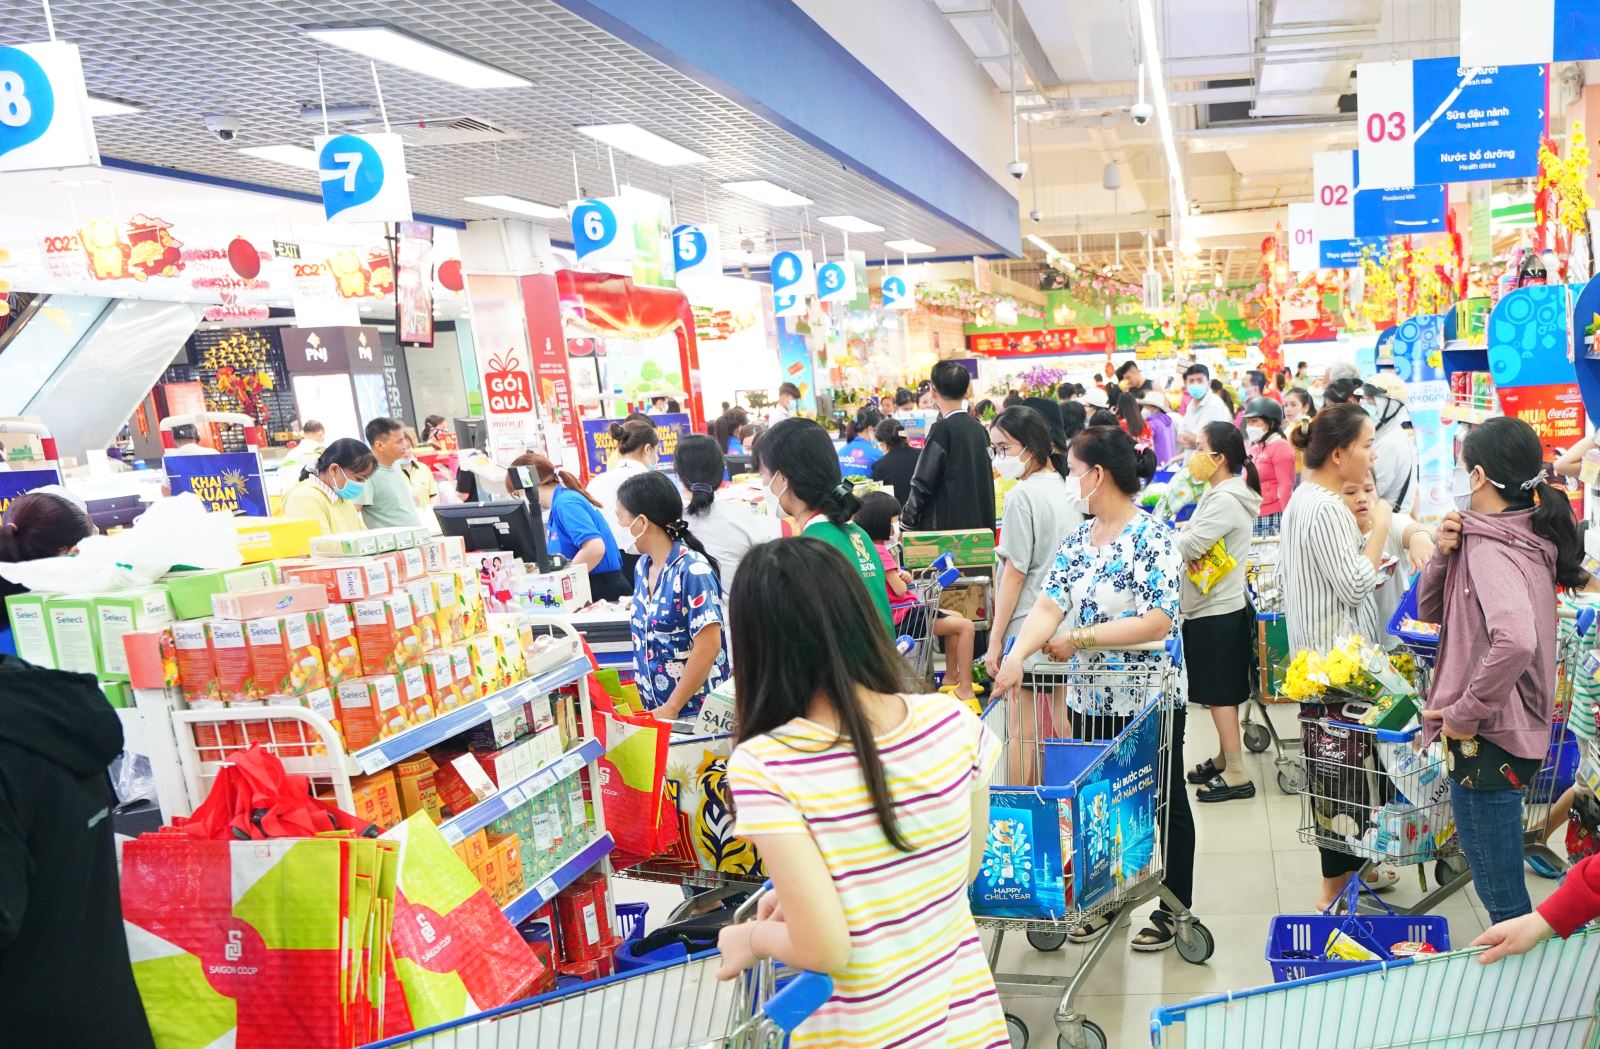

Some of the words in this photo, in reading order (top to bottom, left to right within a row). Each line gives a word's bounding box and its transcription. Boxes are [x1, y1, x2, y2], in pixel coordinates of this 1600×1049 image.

[0, 70, 32, 127] 8
[1446, 110, 1466, 121] Sữa
[1467, 108, 1485, 121] đậu
[1486, 107, 1510, 118] nành
[1366, 111, 1406, 142] 03
[1440, 152, 1468, 163] Nước
[1469, 148, 1482, 161] bổ
[1483, 149, 1516, 161] dưỡng
[333, 151, 364, 193] 7
[1320, 184, 1349, 206] 02
[583, 210, 605, 241] 6
[1295, 228, 1314, 245] 01
[278, 242, 299, 259] EXIT
[678, 233, 697, 261] 5
[778, 257, 796, 281] 4
[824, 269, 840, 289] 3
[305, 346, 329, 363] PNJ
[384, 367, 397, 386] ST
[491, 373, 523, 393] GÓI
[490, 391, 530, 411] QUÀ
[1517, 408, 1547, 424] MUA
[593, 431, 612, 441] KHA
[190, 475, 222, 489] KHAI
[346, 571, 356, 597] Select
[15, 611, 39, 620] Select
[55, 616, 84, 625] Select
[102, 613, 129, 623] Select
[357, 609, 384, 617] Select
[176, 632, 203, 641] Select
[214, 630, 241, 640] Select
[250, 628, 278, 637] Select
[341, 691, 367, 700] Select
[702, 709, 736, 732] SAIG
[1138, 763, 1153, 778] CHILL
[1138, 775, 1155, 791] CHILL
[984, 893, 1009, 901] CHILL
[209, 965, 238, 975] SAIGON
